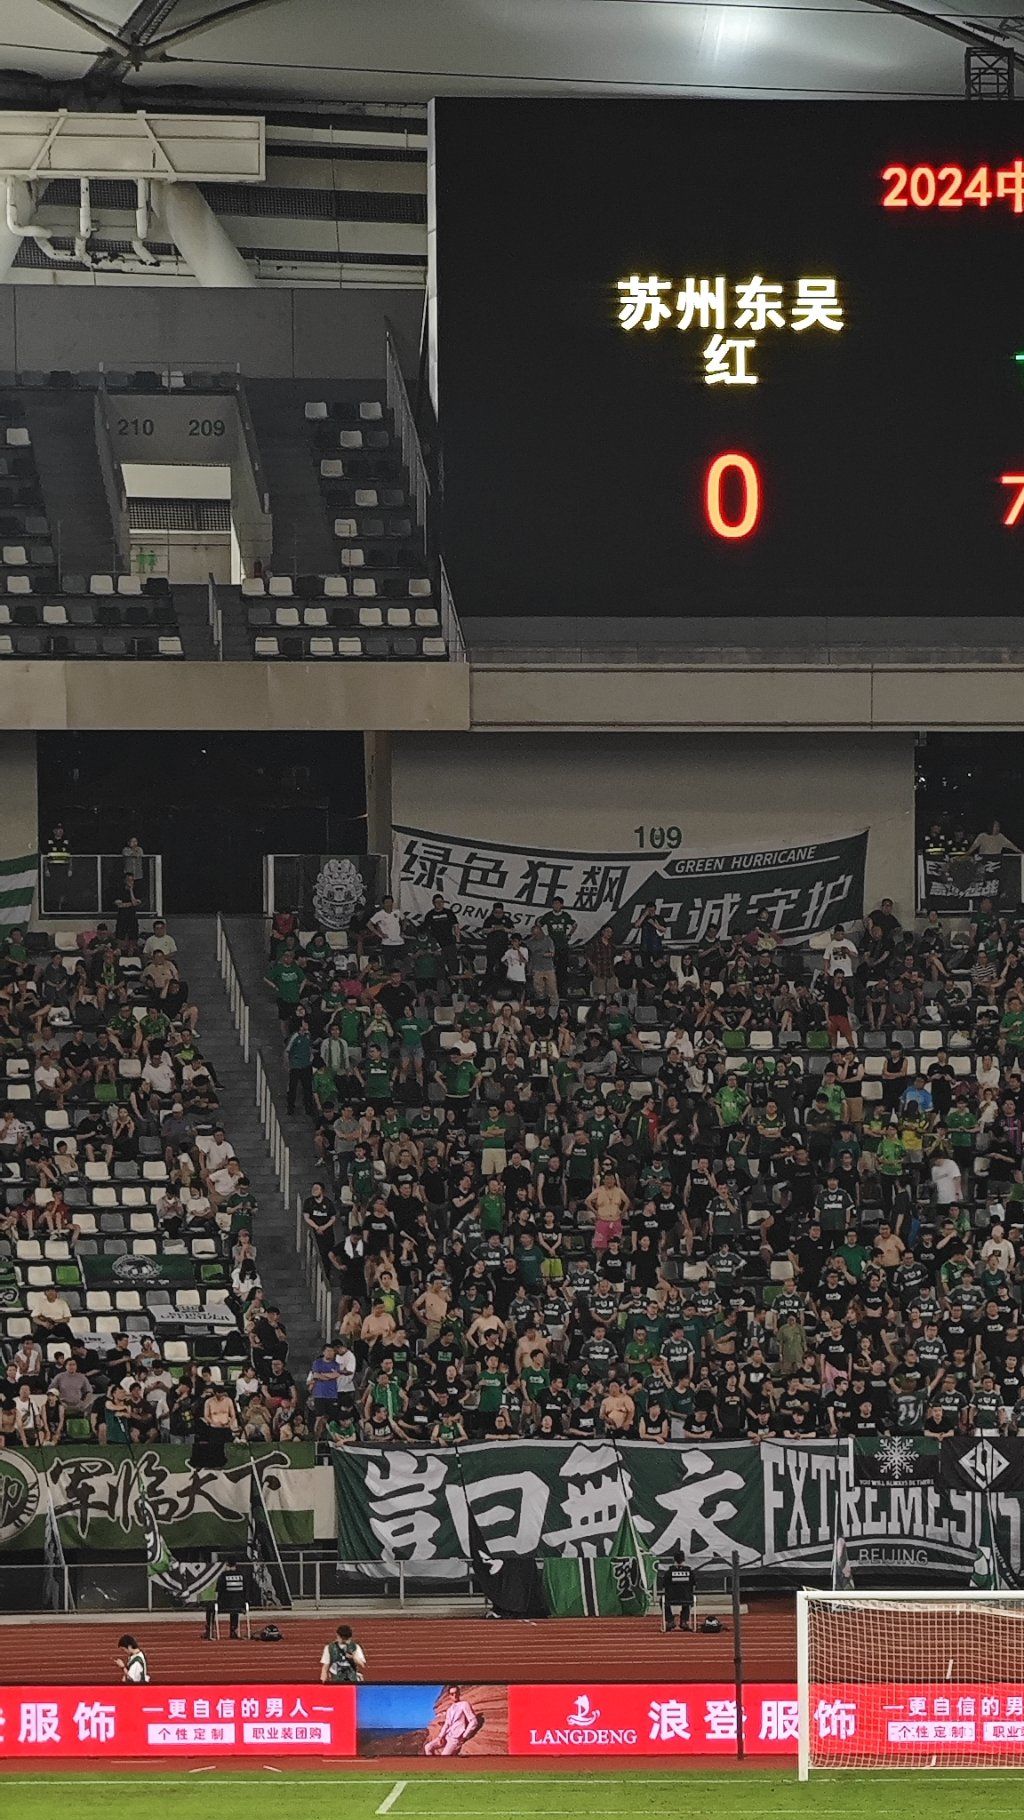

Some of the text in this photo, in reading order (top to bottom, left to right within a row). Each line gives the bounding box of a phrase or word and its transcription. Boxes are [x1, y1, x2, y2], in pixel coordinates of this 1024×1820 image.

[617, 275, 844, 332] 苏州东吴
[703, 334, 758, 386] 红
[118, 418, 155, 436] 210
[188, 419, 226, 436] 209
[705, 453, 761, 539] 0
[633, 825, 683, 850] 109
[675, 845, 817, 874] GREEN HURRICANE
[858, 1547, 928, 1566] BEIJING
[0, 1701, 116, 1743] 服饰
[647, 1699, 857, 1740] 浪登服饰
[157, 1725, 225, 1742] 个性定制
[252, 1724, 324, 1742] 职业装团购
[529, 1728, 637, 1745] LANGDENG
